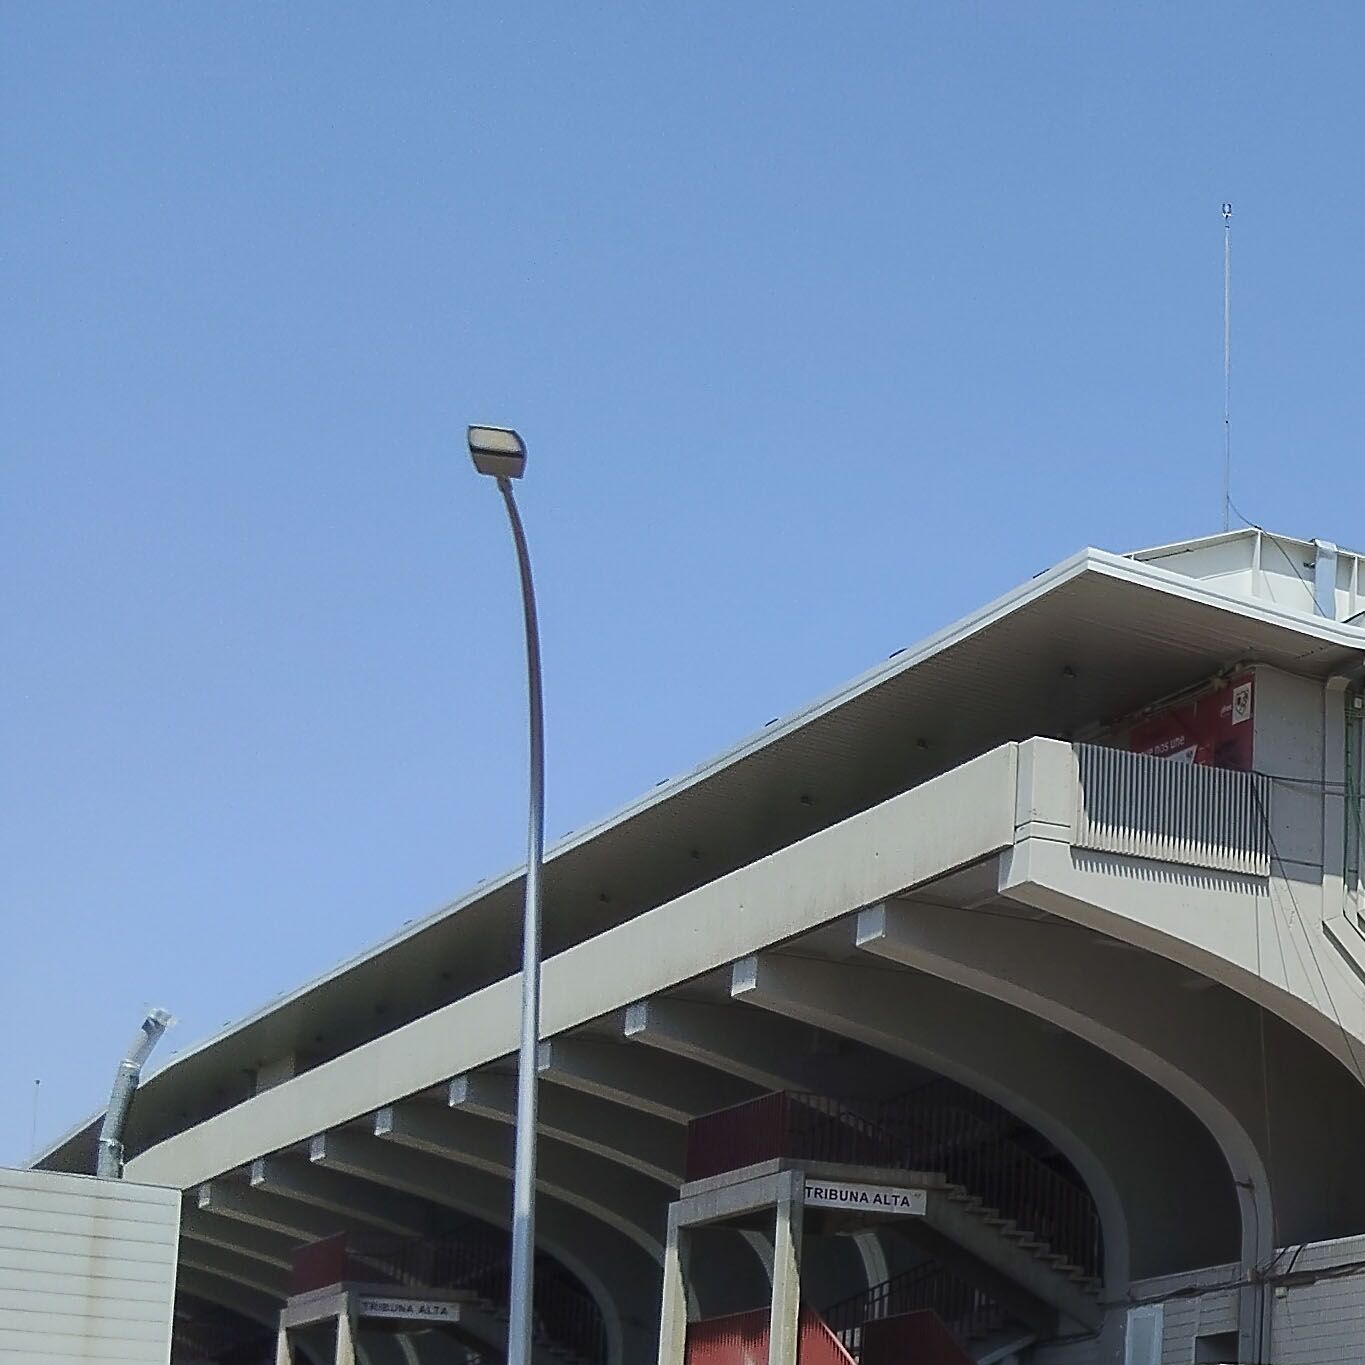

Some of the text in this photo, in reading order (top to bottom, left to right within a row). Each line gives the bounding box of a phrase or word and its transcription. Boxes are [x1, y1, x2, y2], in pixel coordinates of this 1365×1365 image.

[805, 1187, 910, 1207] TRIBUNA ALTA
[419, 1305, 448, 1315] ALTA
